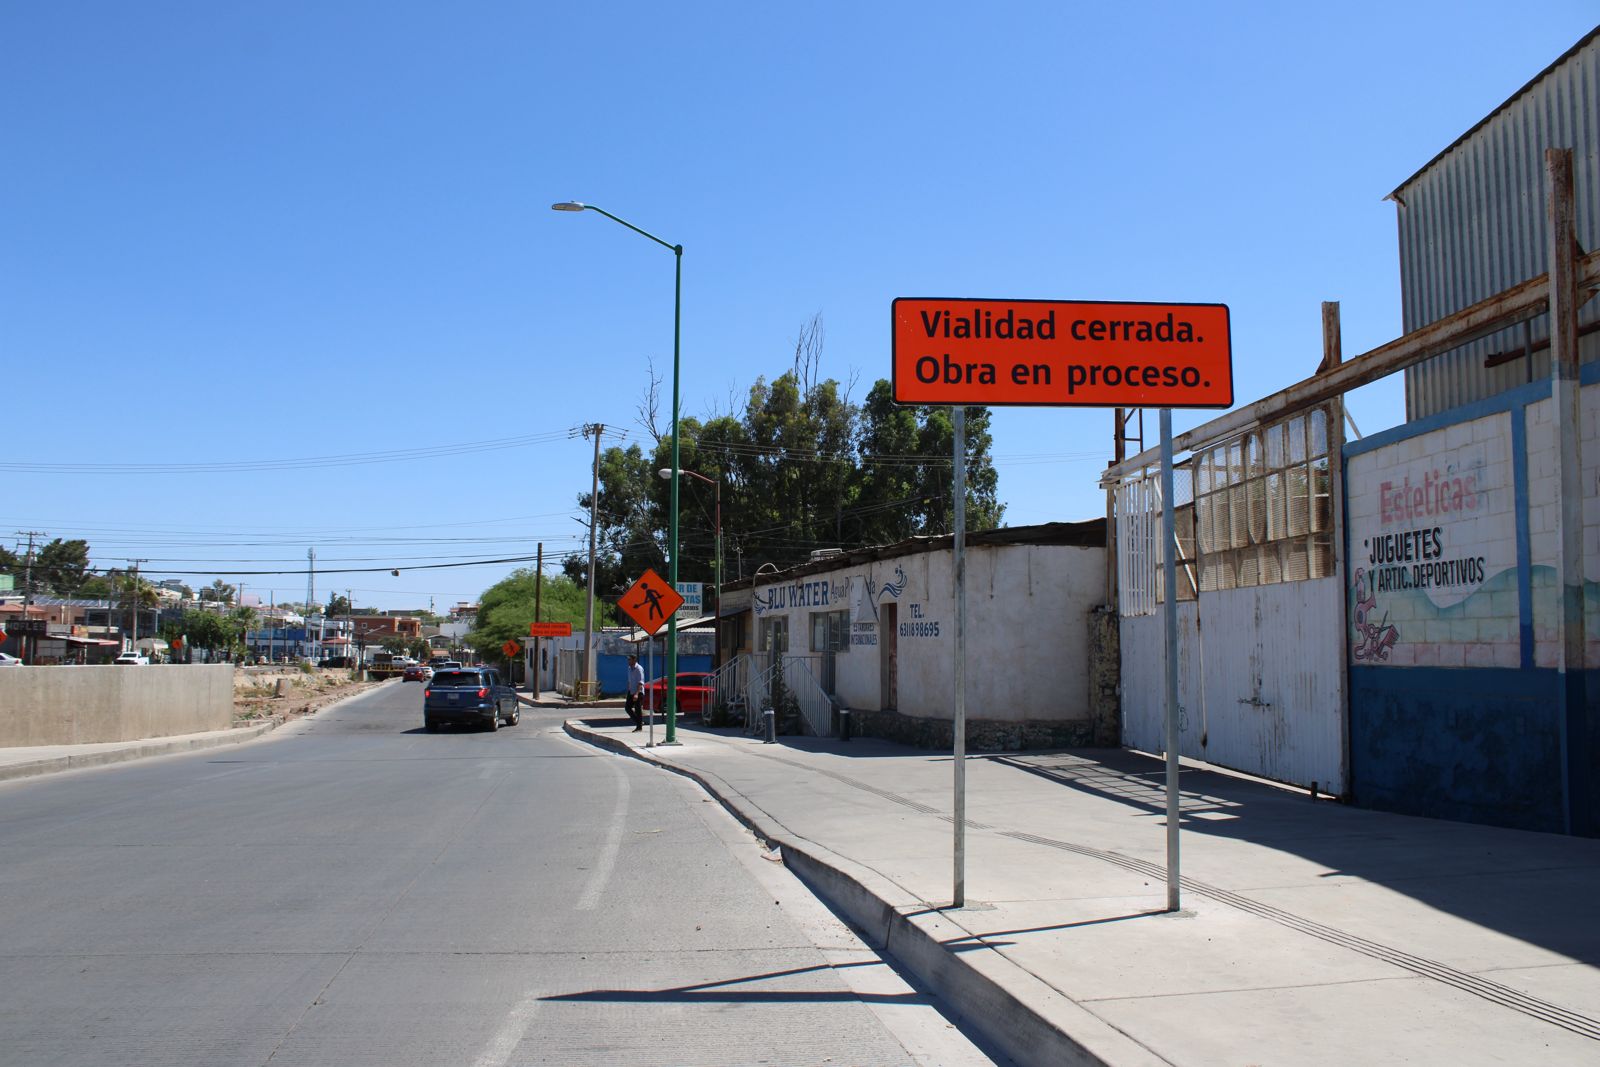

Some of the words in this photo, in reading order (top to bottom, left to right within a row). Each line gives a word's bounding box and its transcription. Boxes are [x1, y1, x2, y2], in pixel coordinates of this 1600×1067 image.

[920, 308, 1056, 340] Vialidad
[1070, 313, 1204, 343] cerrada.
[915, 354, 997, 385] Obra
[1011, 363, 1051, 385] en
[1067, 364, 1211, 395] proceso.
[1380, 469, 1477, 524] Esteticas
[1369, 526, 1442, 565] JUGUETES
[687, 584, 697, 592] DE
[768, 586, 786, 610] BLU
[788, 580, 829, 608] WATER
[1368, 569, 1375, 592] Y
[909, 603, 925, 619] TEL.
[899, 621, 940, 637] 6311898695
